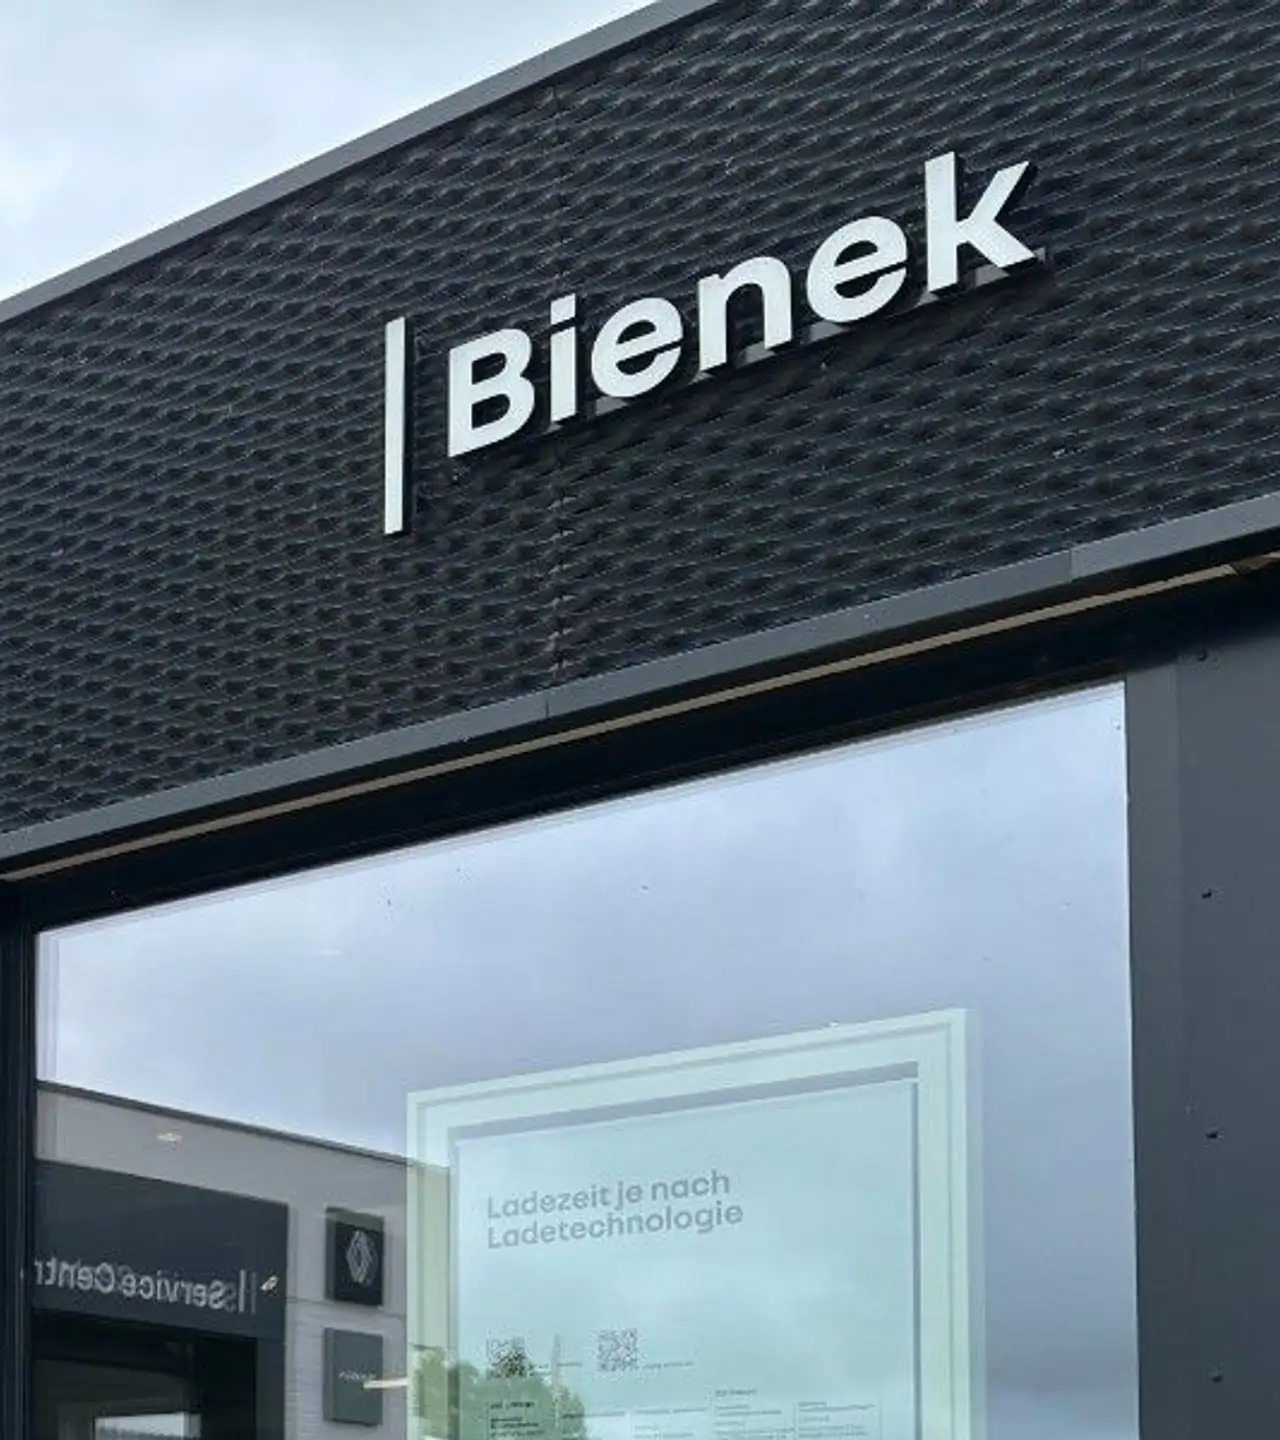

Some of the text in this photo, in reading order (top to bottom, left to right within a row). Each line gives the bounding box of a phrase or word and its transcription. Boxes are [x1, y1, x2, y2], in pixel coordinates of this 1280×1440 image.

[447, 151, 1039, 458] Bienek
[488, 1169, 730, 1219] Ladezeit je nach
[488, 1201, 743, 1249] Ladetechnologie
